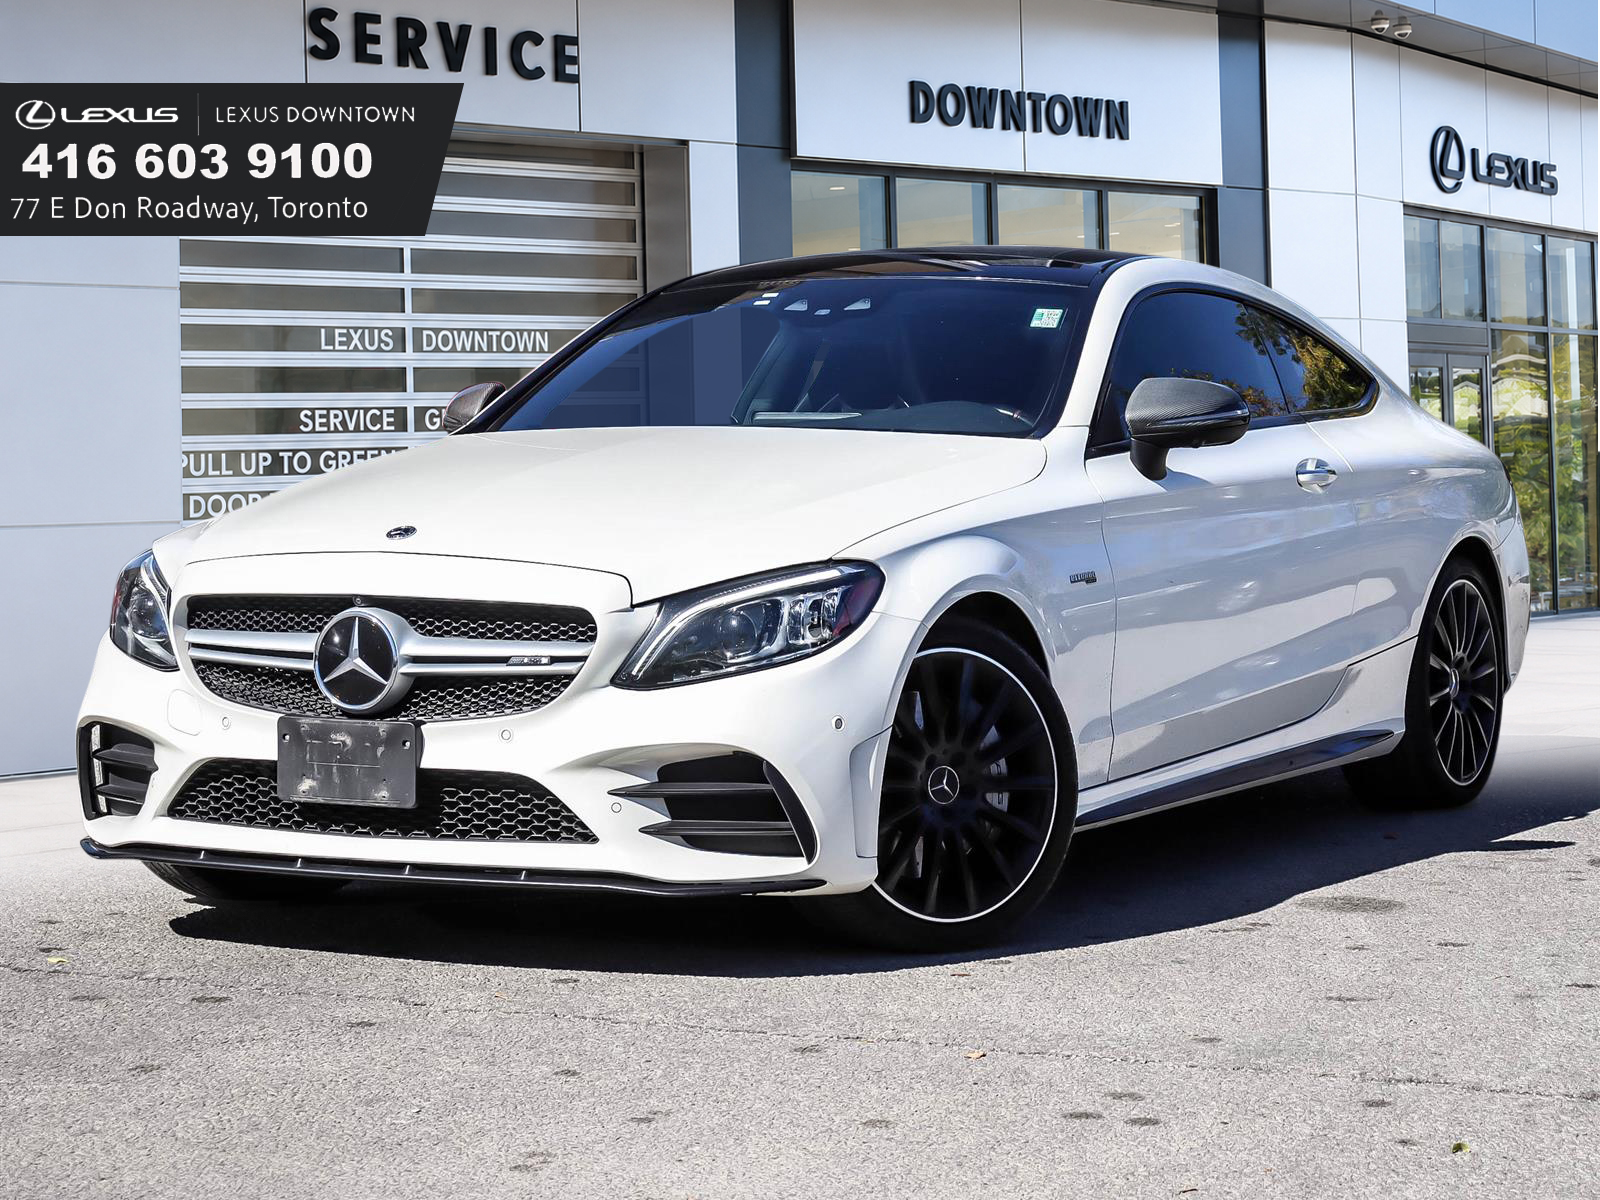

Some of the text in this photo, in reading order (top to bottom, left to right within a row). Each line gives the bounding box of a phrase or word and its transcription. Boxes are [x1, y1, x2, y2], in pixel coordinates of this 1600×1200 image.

[308, 7, 579, 83] SERVICE
[909, 80, 1130, 141] DOWNTOWN
[1470, 147, 1558, 196] LEXUS
[320, 328, 549, 352] LEXUS DOWNTOWN
[299, 408, 395, 432] SERVICE
[240, 452, 273, 475] UP
[279, 451, 312, 474] TO
